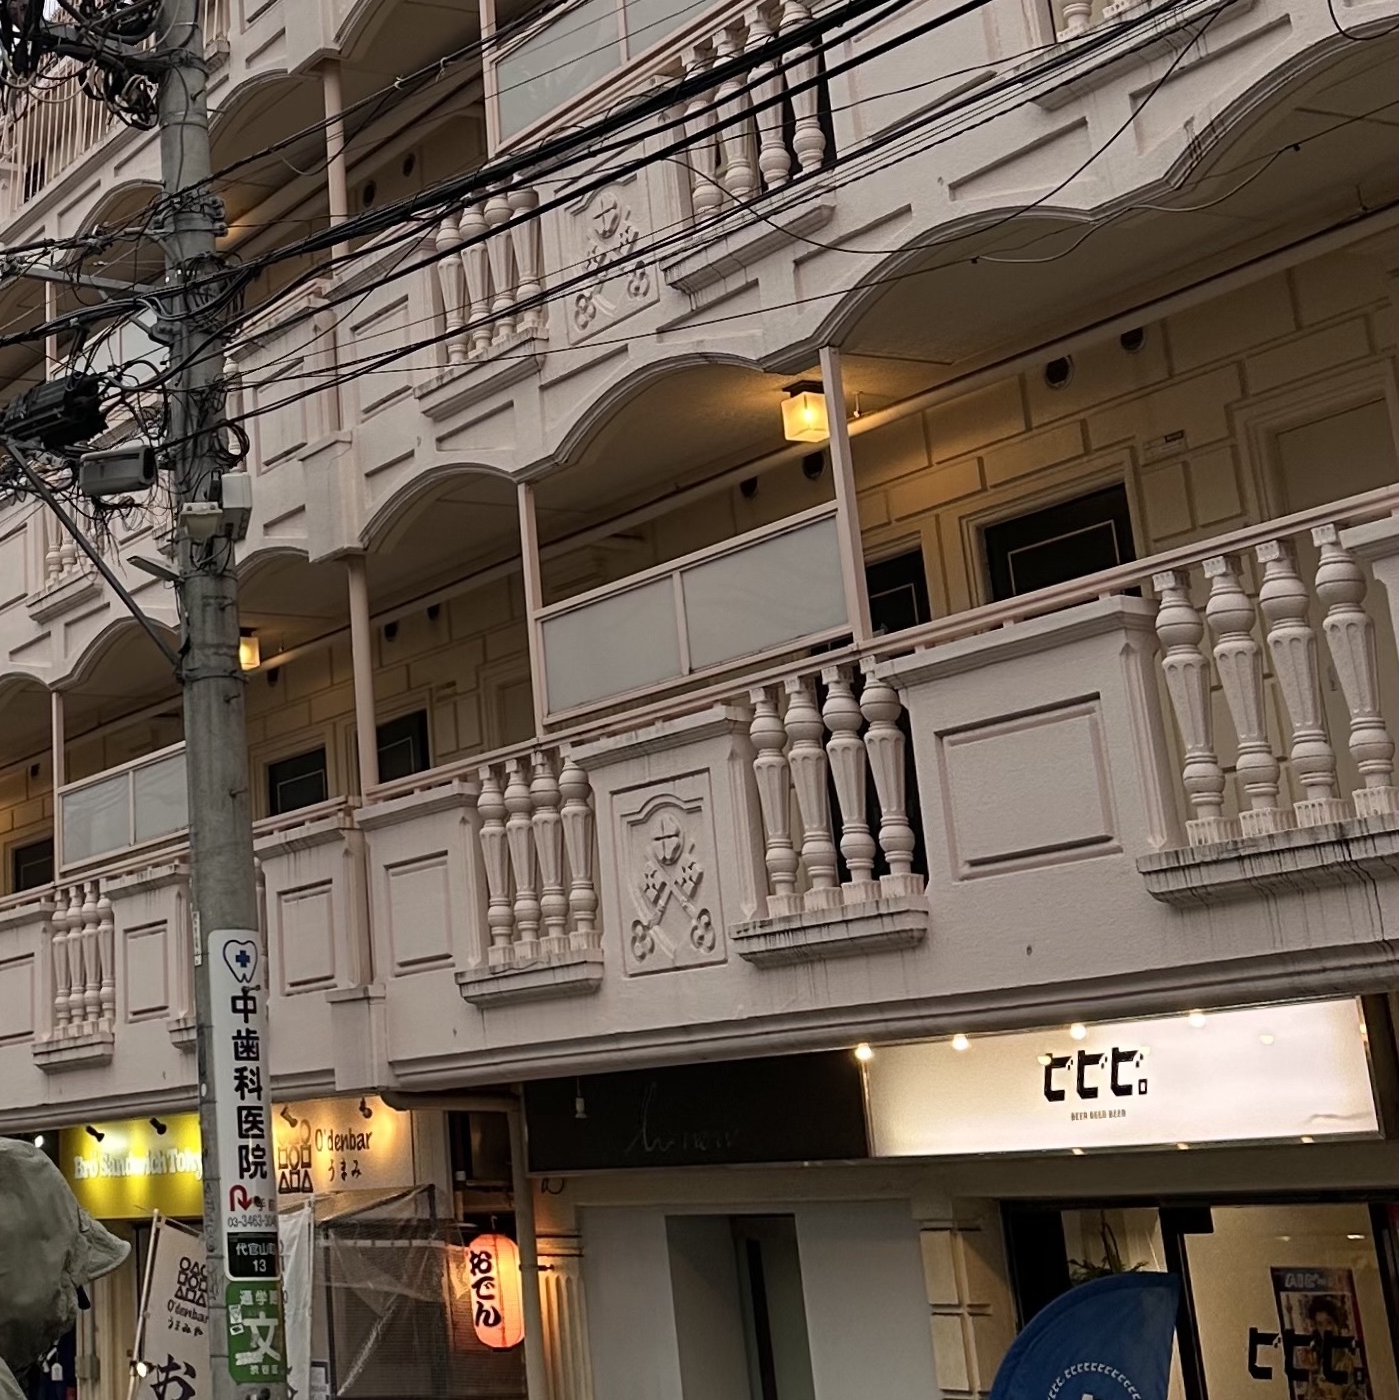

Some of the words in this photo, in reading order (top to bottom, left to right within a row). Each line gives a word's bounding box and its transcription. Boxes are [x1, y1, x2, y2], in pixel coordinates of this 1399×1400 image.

[230, 986, 268, 1181] 中歯科医院
[253, 1259, 267, 1272] 13
[469, 1250, 502, 1327] おでん
[242, 1311, 281, 1362] 文
